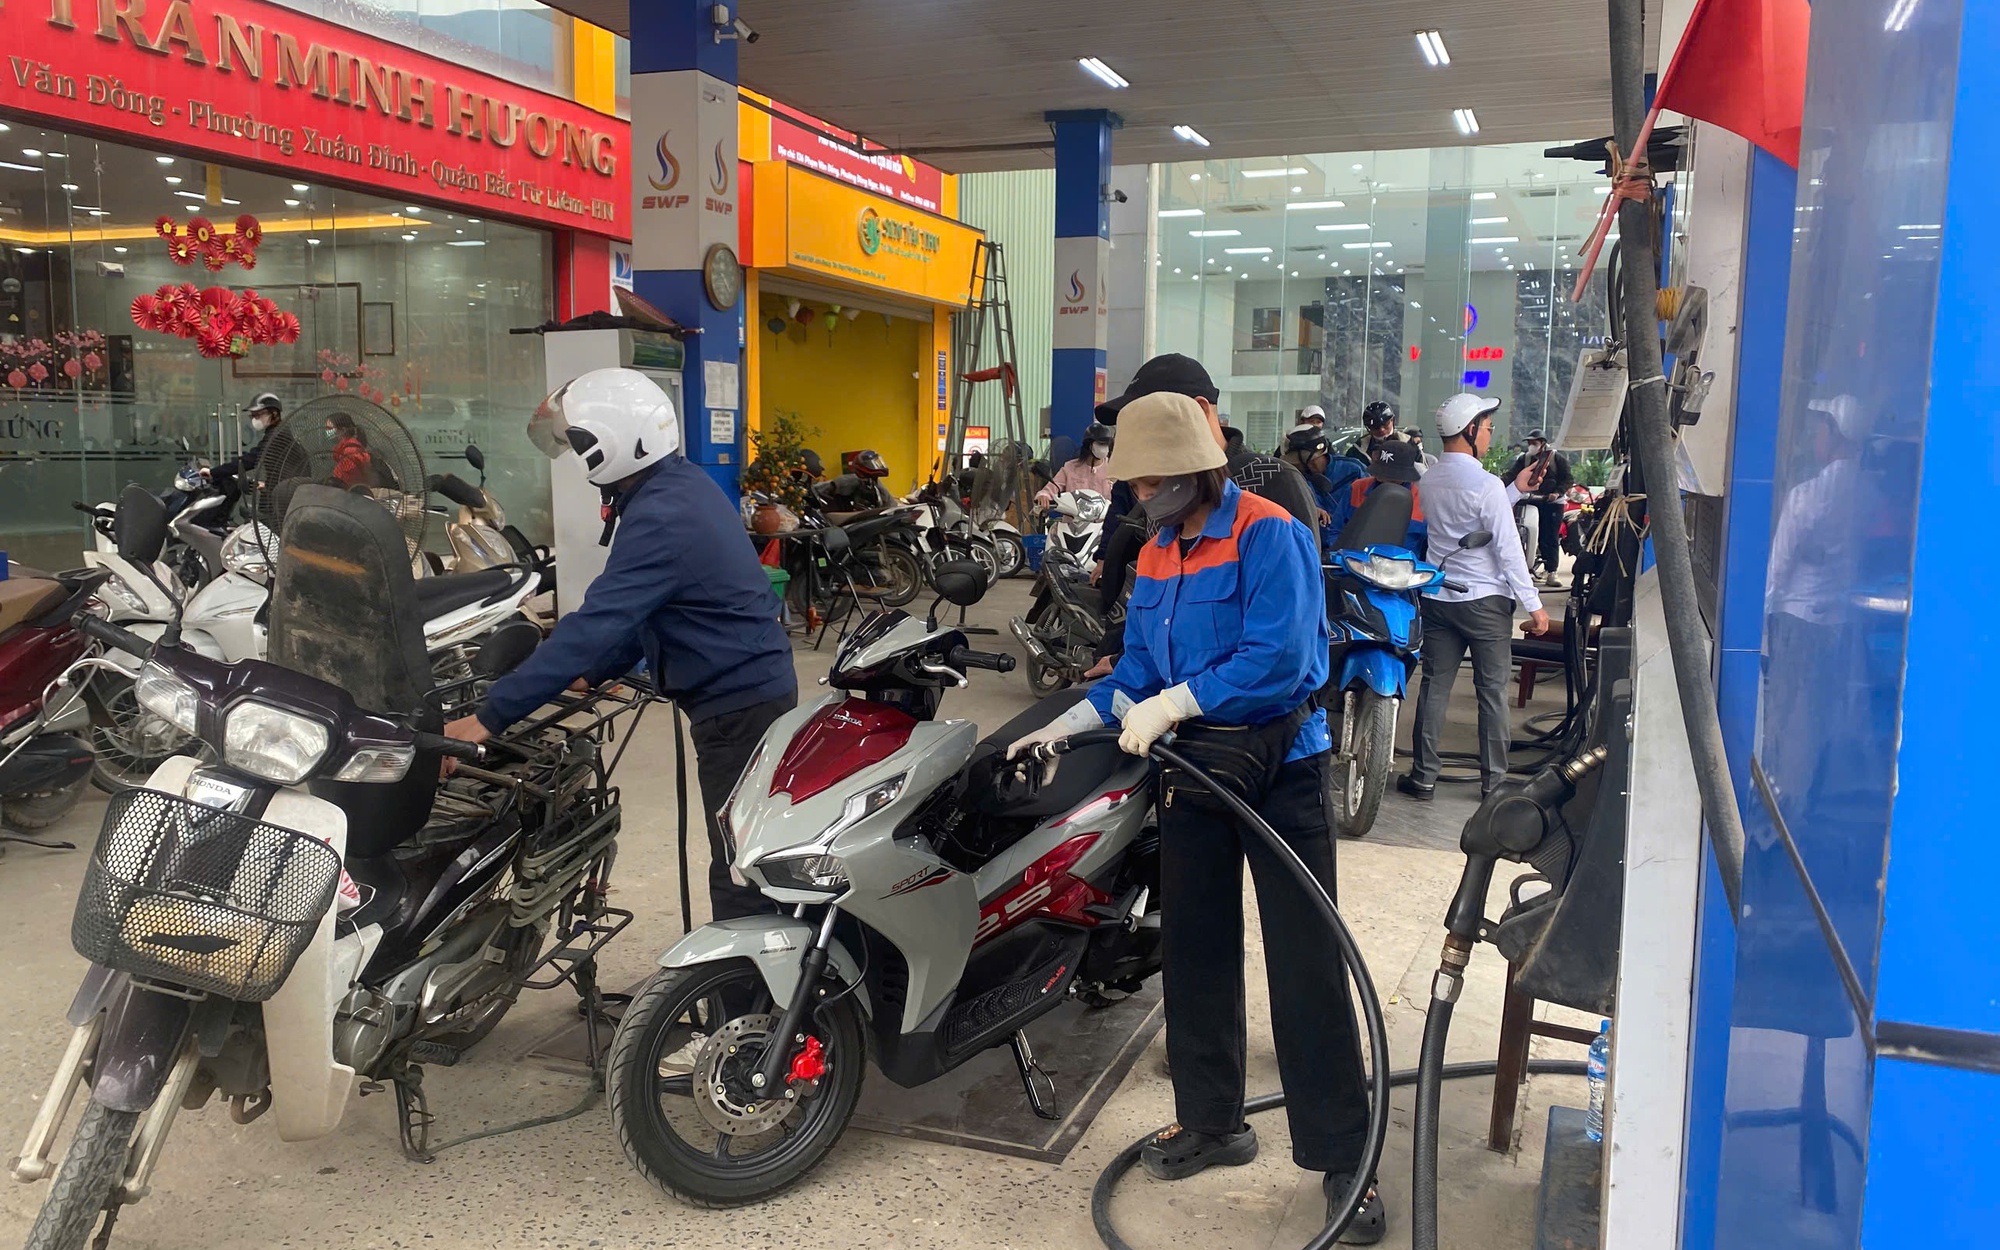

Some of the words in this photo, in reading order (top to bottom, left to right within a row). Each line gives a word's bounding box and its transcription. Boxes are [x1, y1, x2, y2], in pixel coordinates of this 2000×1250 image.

[273, 32, 436, 128] MINH
[446, 84, 616, 177] HƯƠNG
[9, 55, 77, 100] Văn
[86, 73, 165, 126] Đồng
[188, 98, 295, 156] Phường
[431, 159, 480, 192] Quận
[485, 169, 516, 198] Bắc
[518, 179, 543, 205] Từ
[642, 195, 690, 209] SWP
[705, 197, 733, 215] SWP
[1059, 306, 1089, 315] SWP
[193, 778, 232, 796] HONDA
[890, 864, 930, 893] SPORT
